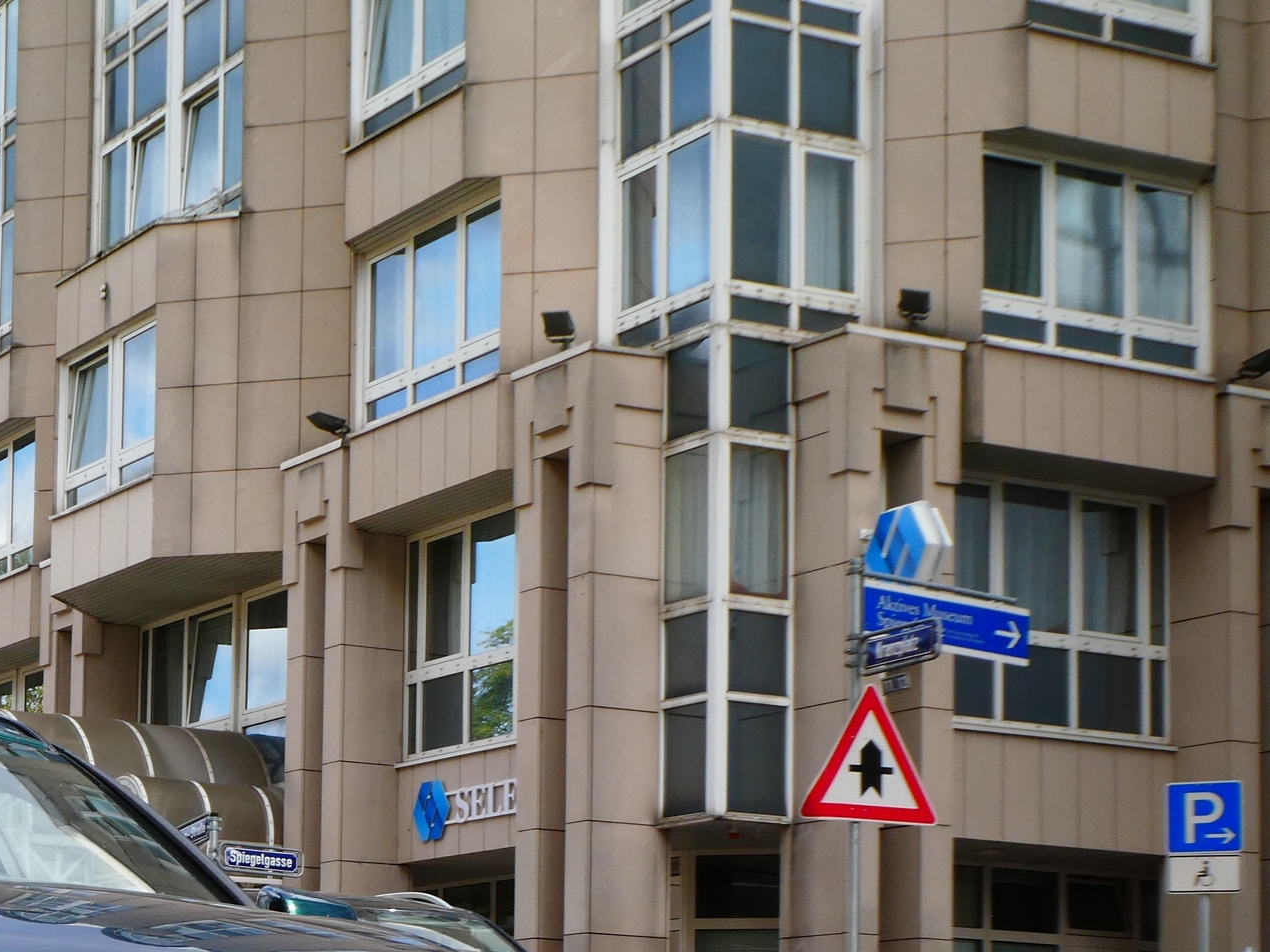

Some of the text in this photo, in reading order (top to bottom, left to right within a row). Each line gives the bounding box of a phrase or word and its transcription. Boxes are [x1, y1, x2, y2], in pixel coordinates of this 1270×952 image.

[922, 602, 974, 625] Museum
[1184, 791, 1225, 844] P
[230, 849, 293, 868] Spiegelgasse
